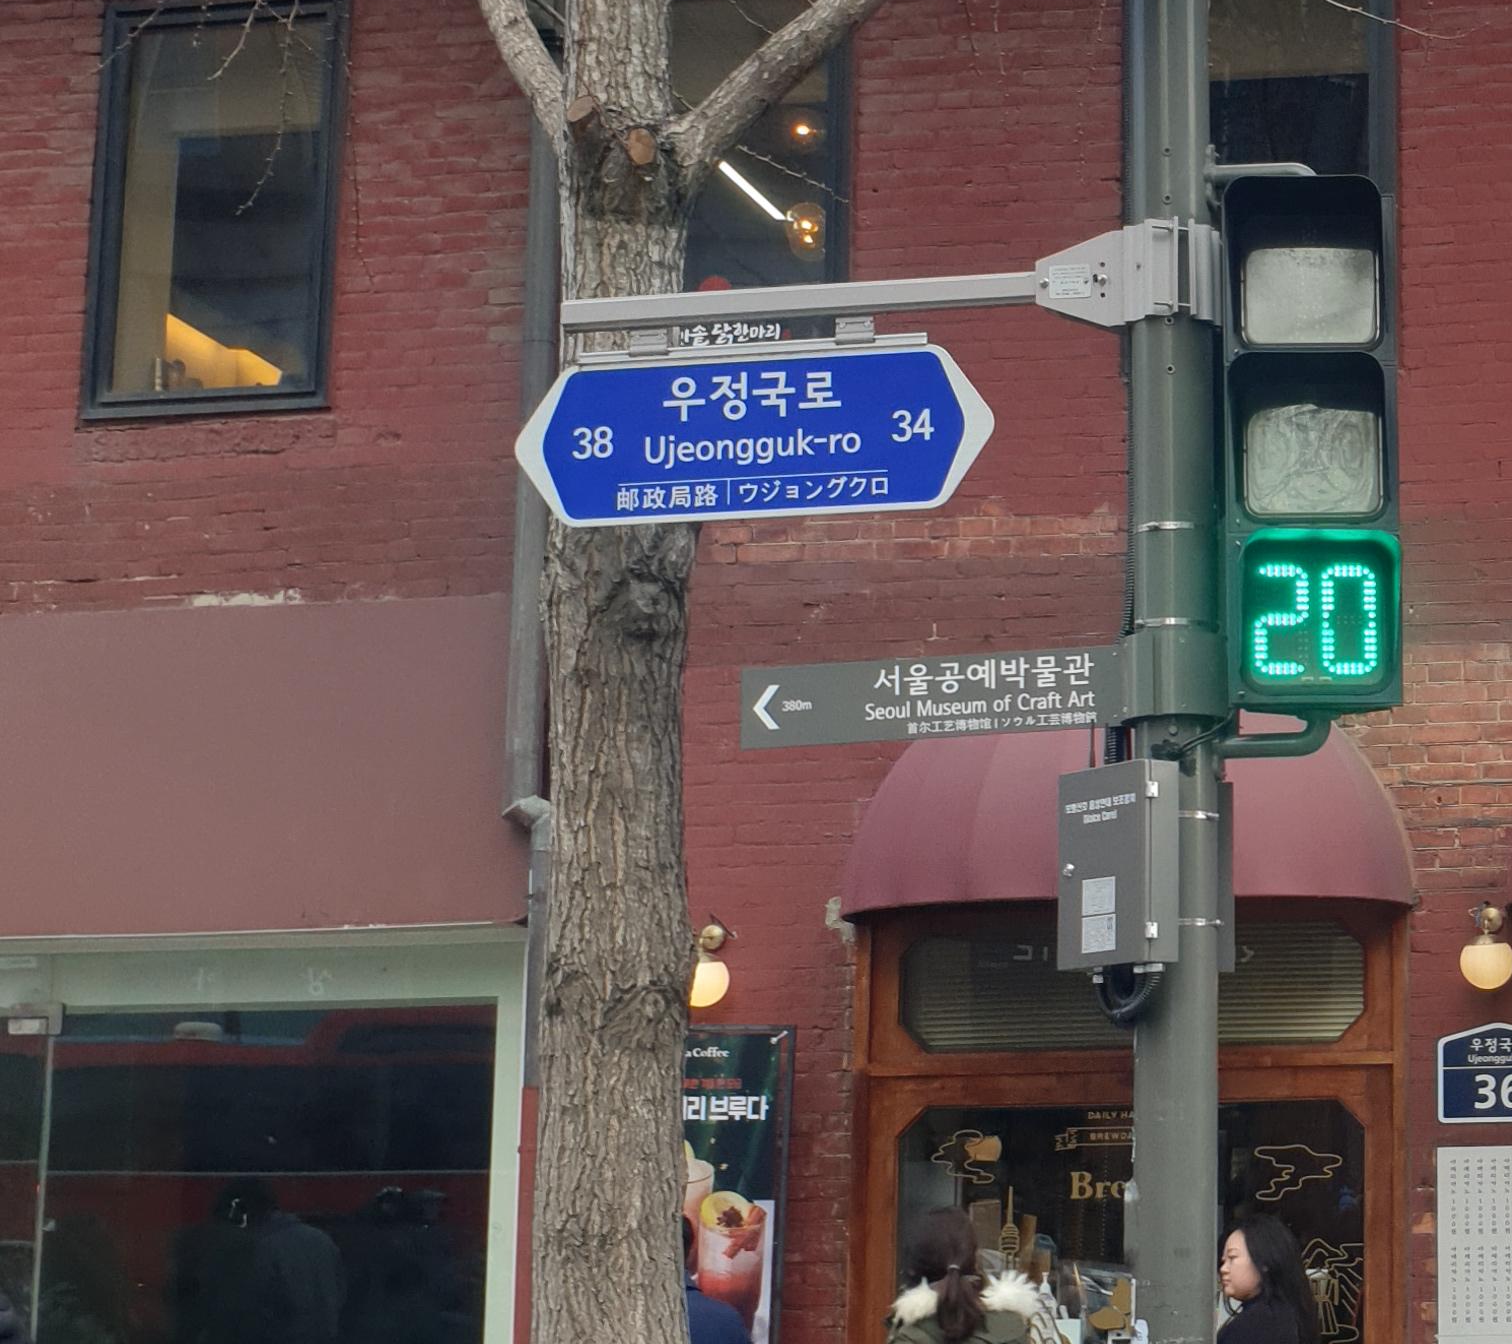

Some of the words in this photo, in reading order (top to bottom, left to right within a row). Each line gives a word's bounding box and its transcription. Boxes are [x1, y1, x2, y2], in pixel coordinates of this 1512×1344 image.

[662, 370, 842, 422] 우정국로
[572, 426, 614, 460] 38
[890, 409, 935, 443] 34
[643, 427, 862, 469] Ujeongguk-ro
[616, 482, 719, 512] 邮政局路
[738, 477, 889, 505] ウジョングクロ
[1254, 563, 1378, 676] 20
[873, 653, 1095, 696] 서울공예박물관
[865, 701, 911, 721] Seoul
[916, 699, 987, 718] Museum
[993, 693, 1013, 712] of
[1017, 691, 1062, 710] Craft
[1067, 689, 1096, 708] Art
[682, 1095, 706, 1121] 리
[708, 1095, 769, 1121] 브루다
